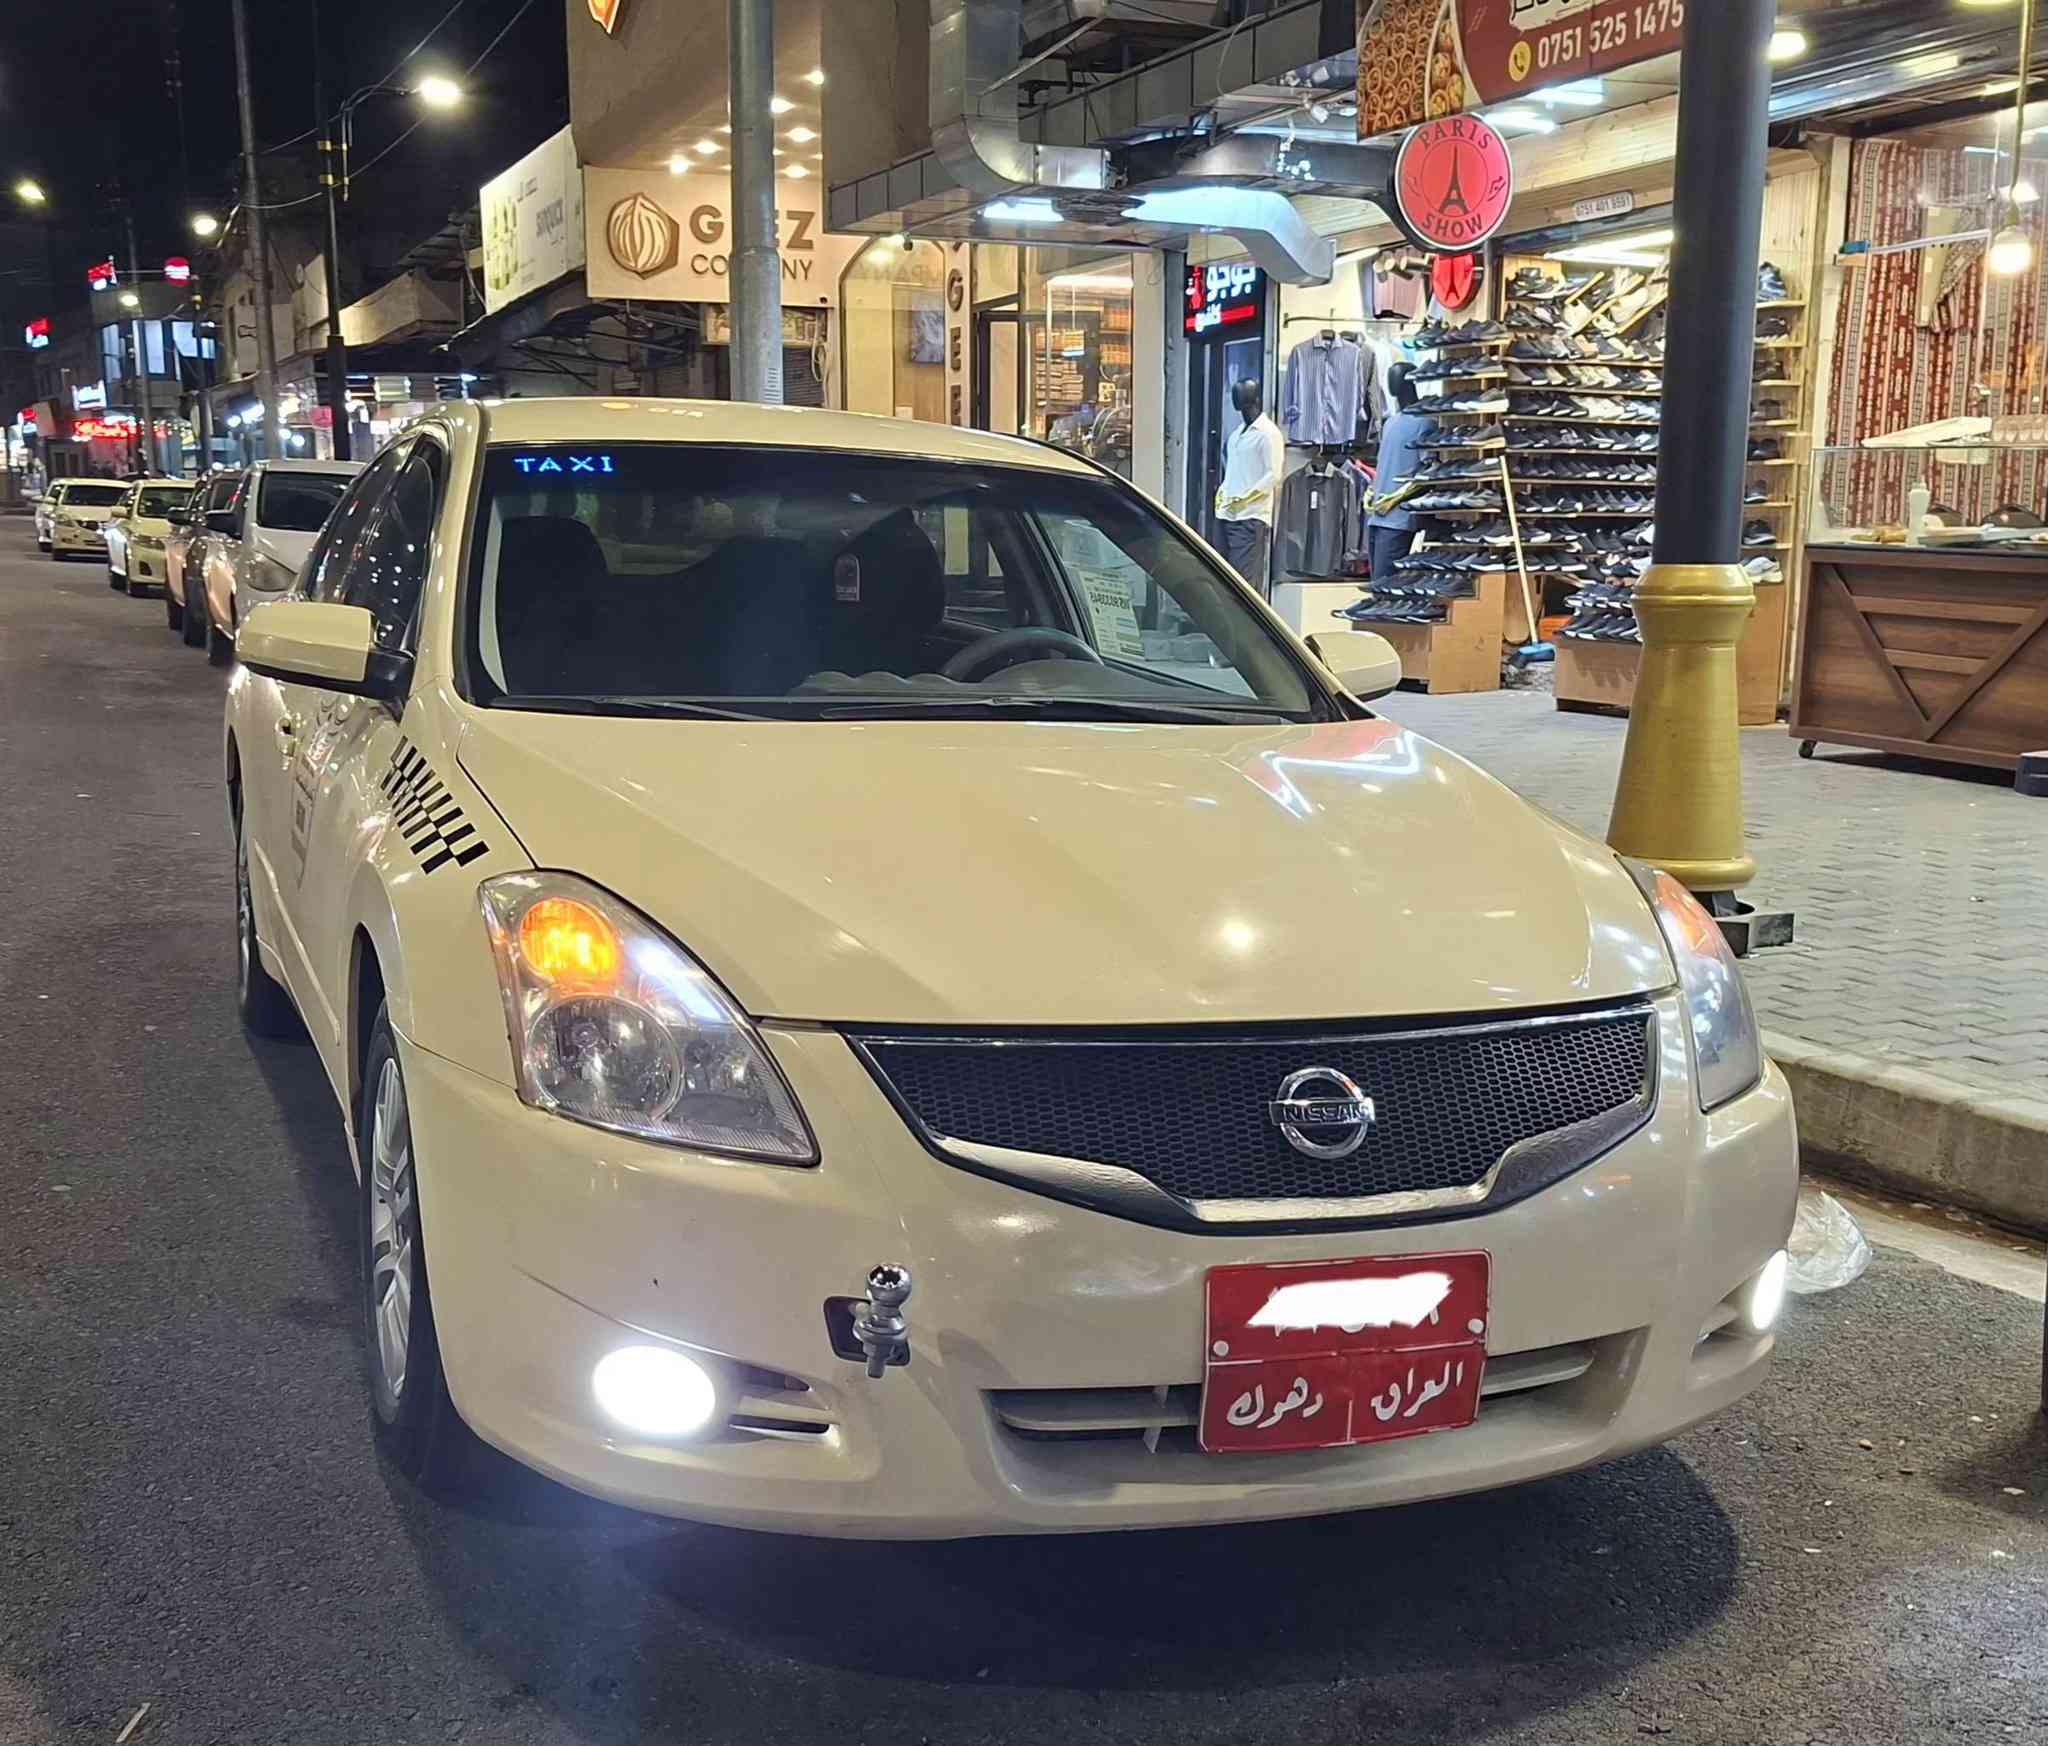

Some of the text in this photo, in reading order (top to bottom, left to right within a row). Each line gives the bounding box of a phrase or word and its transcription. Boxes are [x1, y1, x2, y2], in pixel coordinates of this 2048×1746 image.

[1537, 27, 1583, 69] 0751
[1589, 12, 1628, 54] 525
[1633, 0, 1685, 40] 1475
[1419, 118, 1493, 150] PARIS
[689, 204, 816, 250] GZ
[1422, 212, 1483, 239] SHOW
[690, 253, 813, 281] CONY
[513, 455, 614, 473] TAXI
[1281, 1102, 1365, 1122] NISSAN
[1226, 1360, 1464, 1429] العراق دهوك
